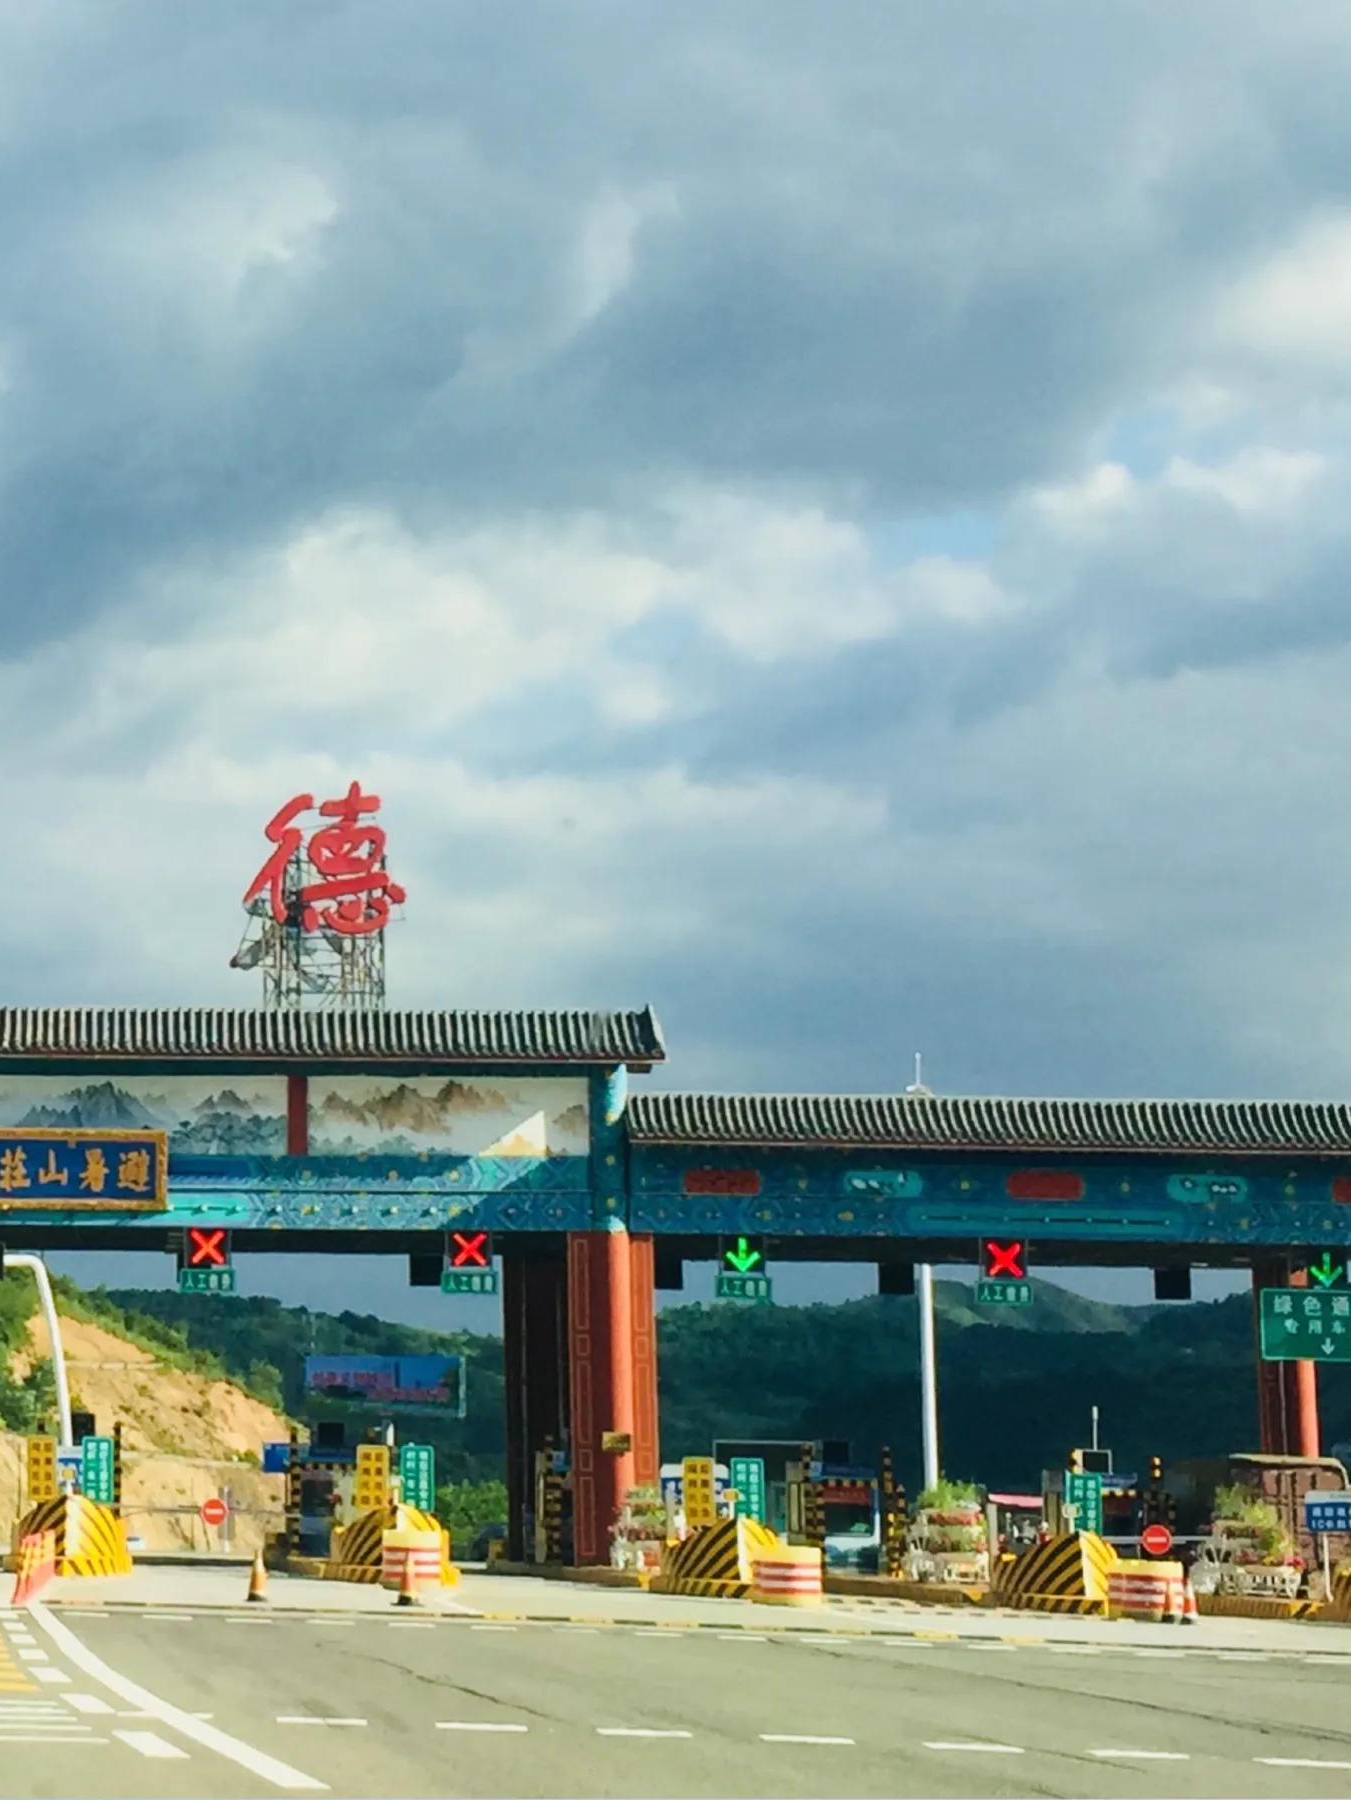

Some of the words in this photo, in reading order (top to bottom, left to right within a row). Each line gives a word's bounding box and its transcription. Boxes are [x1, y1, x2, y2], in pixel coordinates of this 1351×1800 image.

[185, 1270, 230, 1290] 人工
[448, 1274, 493, 1292] 人工
[721, 1278, 767, 1297] 人工
[980, 1283, 1029, 1302] 人工
